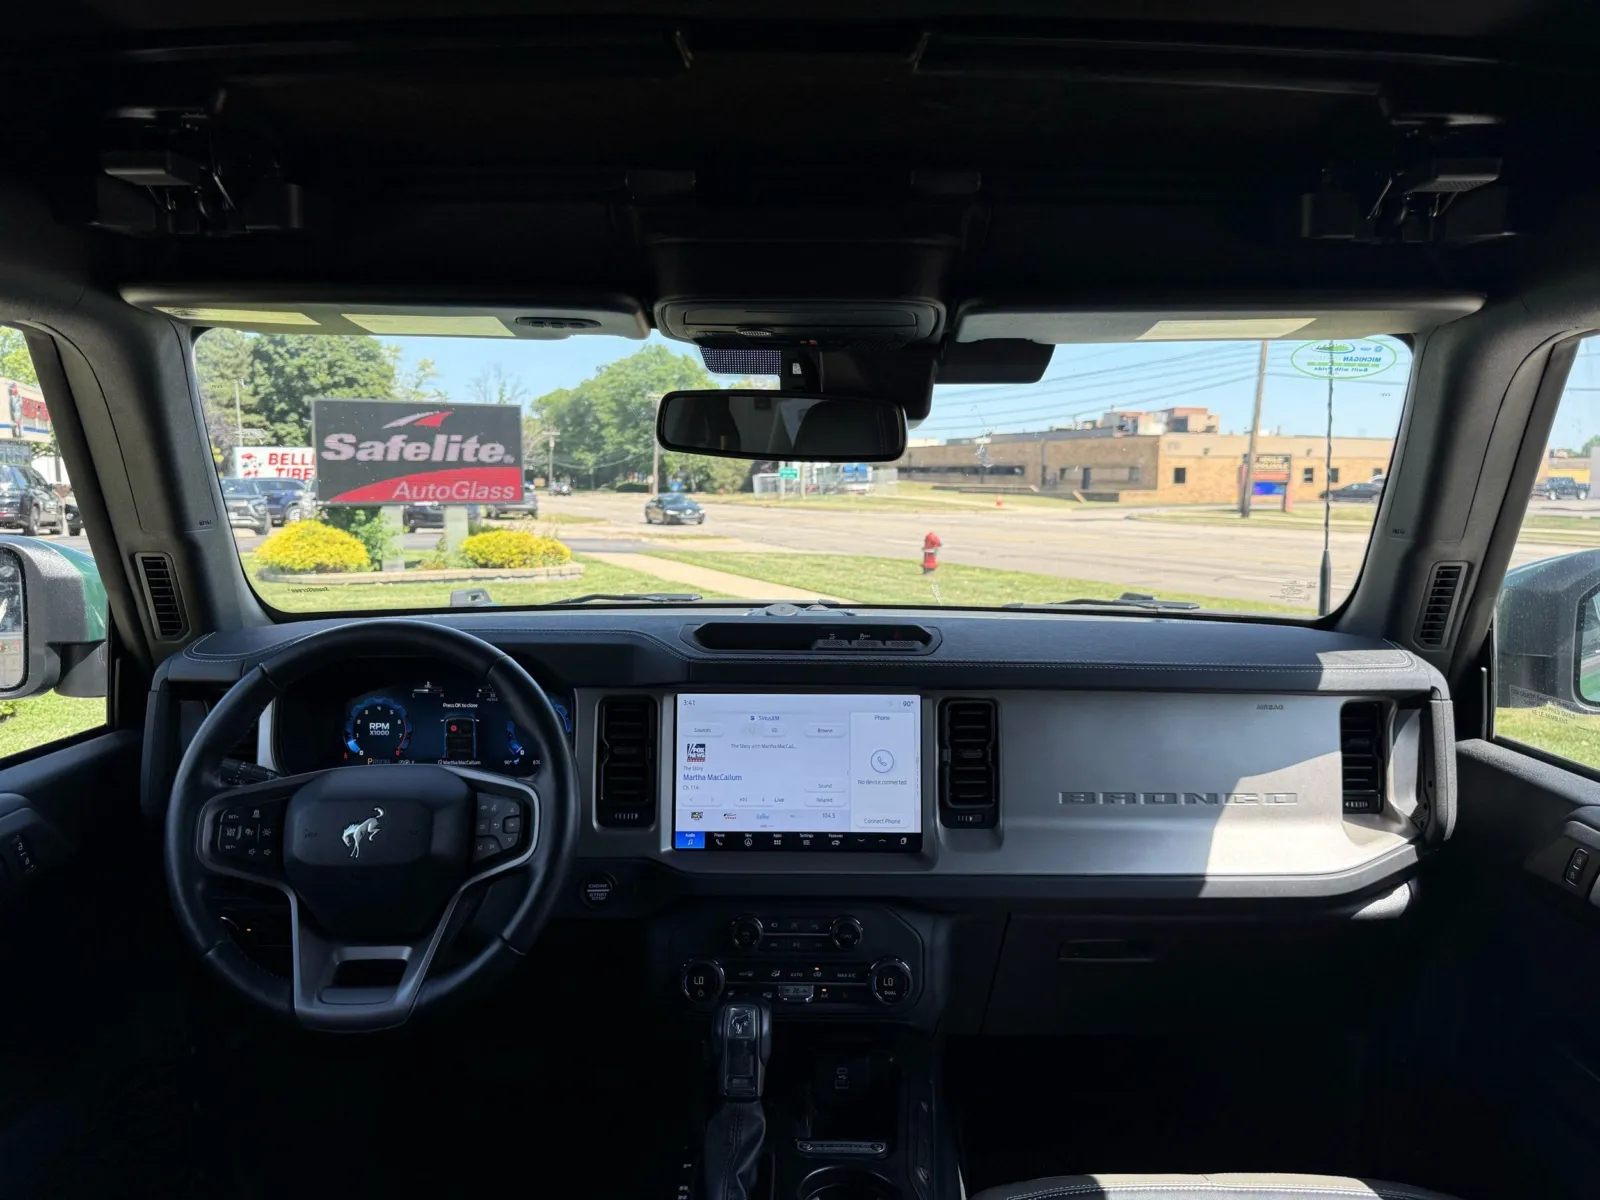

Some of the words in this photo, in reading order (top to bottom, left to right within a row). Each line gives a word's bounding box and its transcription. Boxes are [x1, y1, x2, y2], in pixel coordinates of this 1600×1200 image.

[391, 481, 515, 500] AutoGlass
[683, 773, 706, 781] Martha
[707, 773, 742, 781] MacCallum
[1058, 792, 1298, 805] BRONCO
